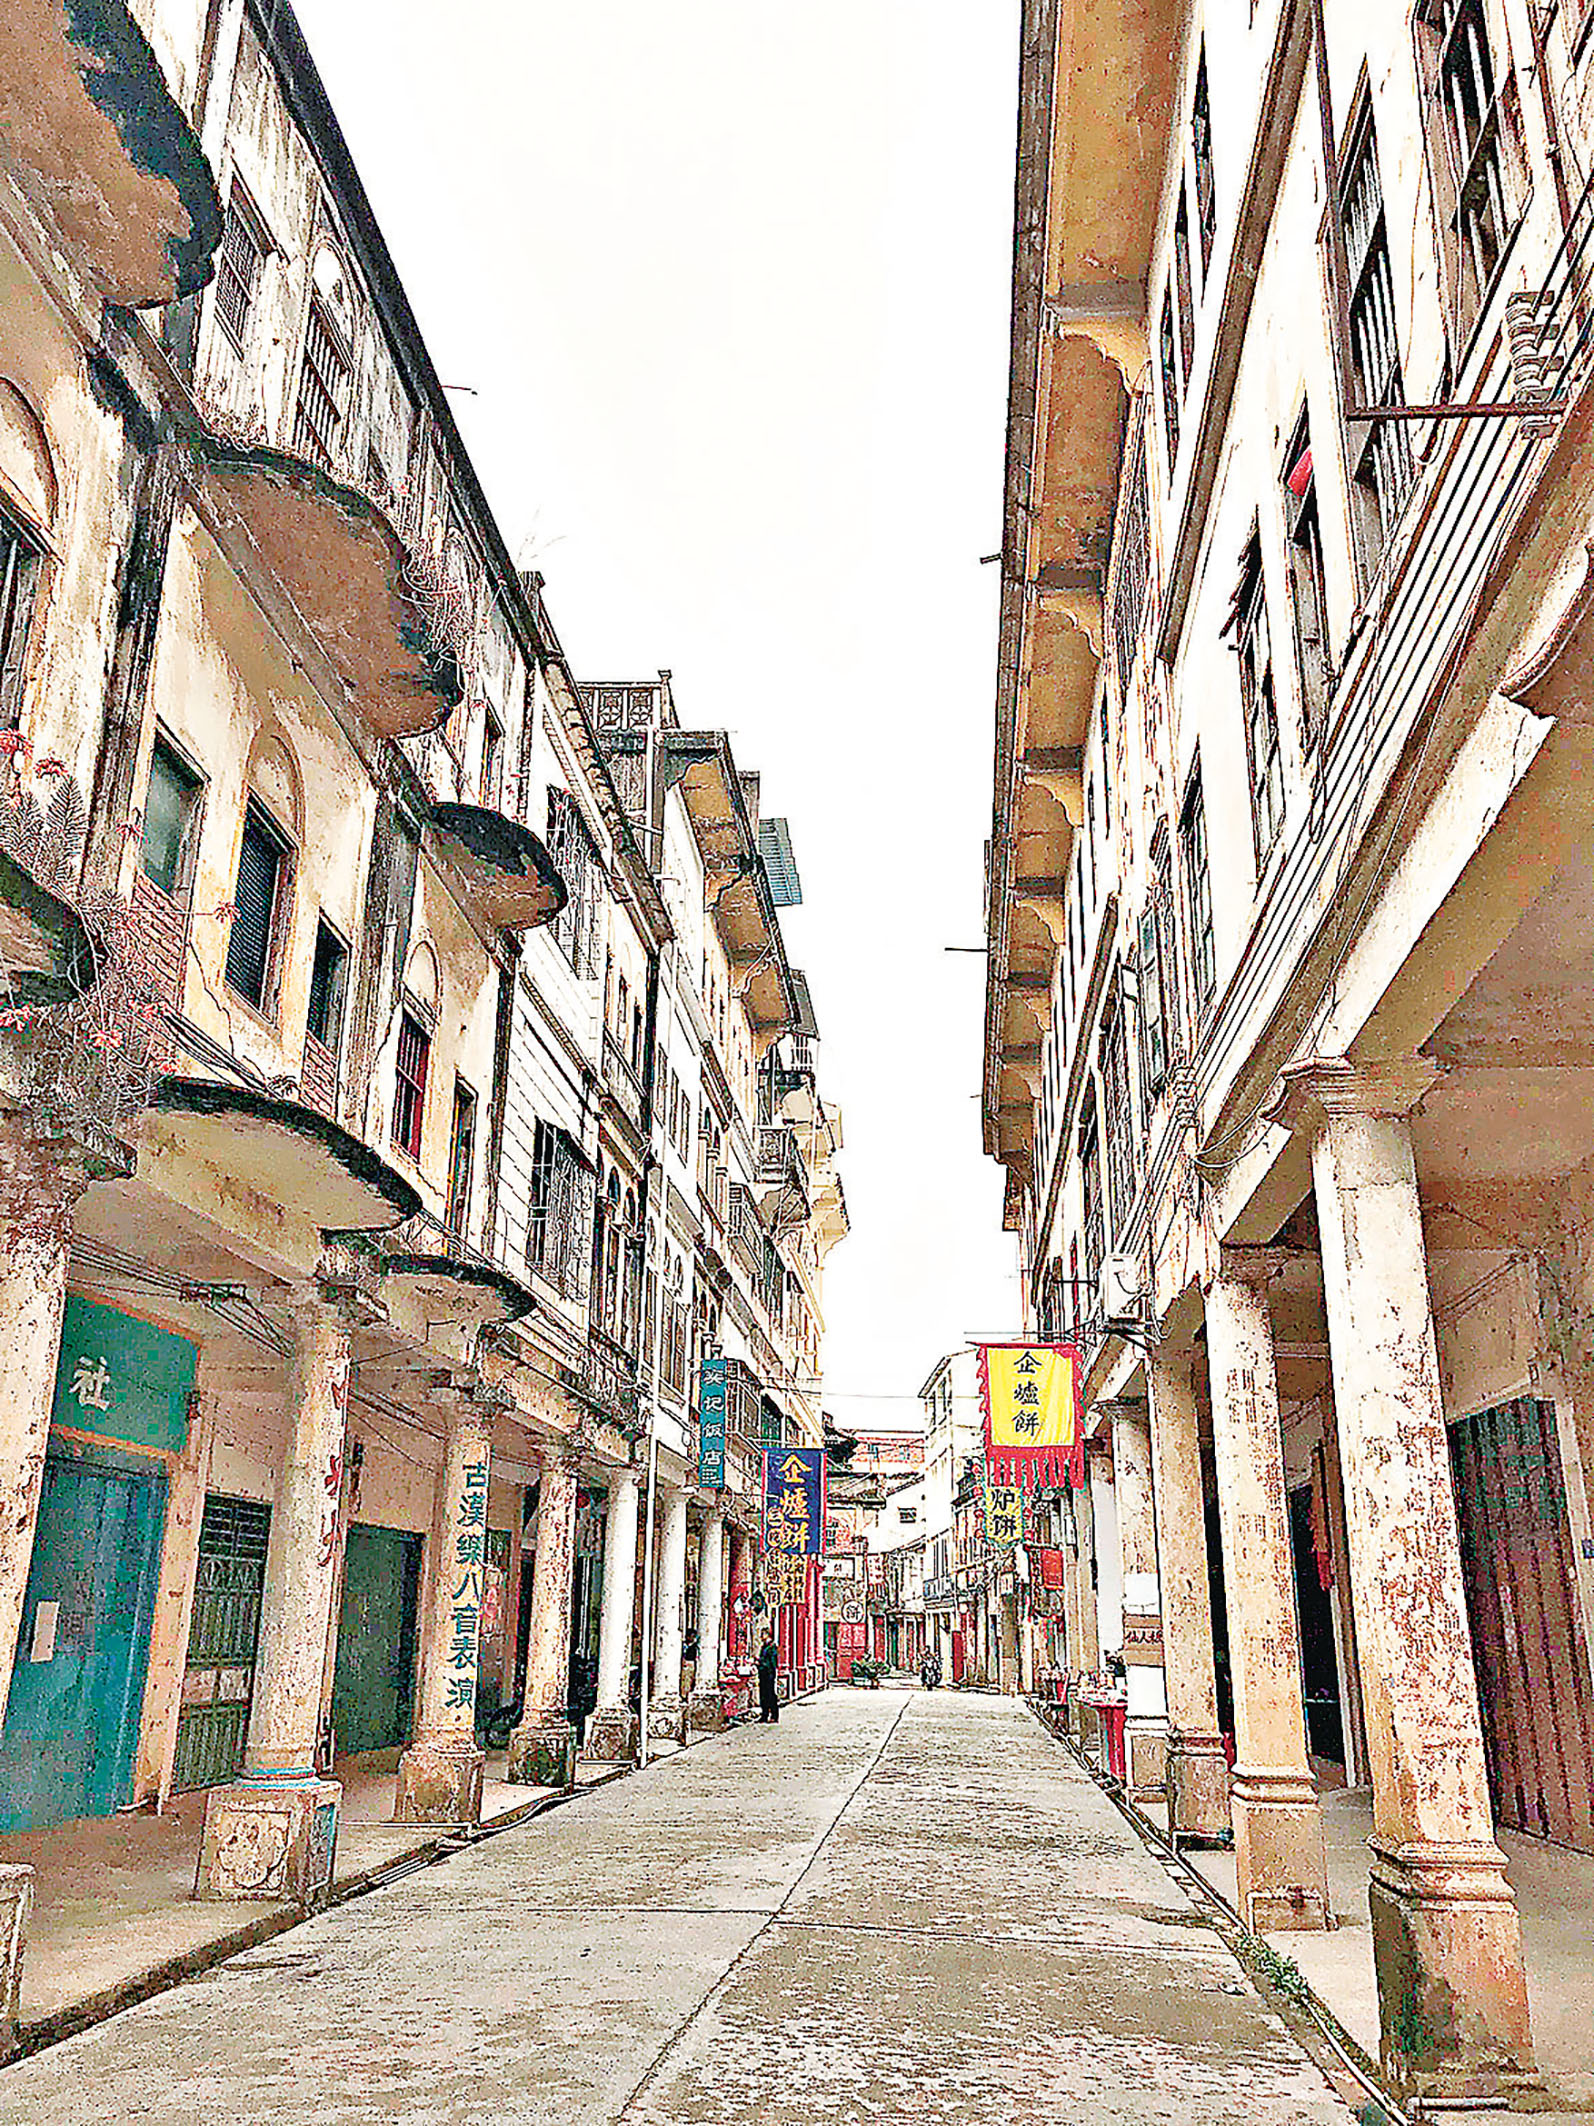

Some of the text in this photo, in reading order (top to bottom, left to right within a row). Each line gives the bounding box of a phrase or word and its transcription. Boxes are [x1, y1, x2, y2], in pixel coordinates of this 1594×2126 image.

[68, 1356, 110, 1412] 社
[1012, 1350, 1043, 1437] 企爐餅
[991, 1488, 1017, 1538] 炉饼
